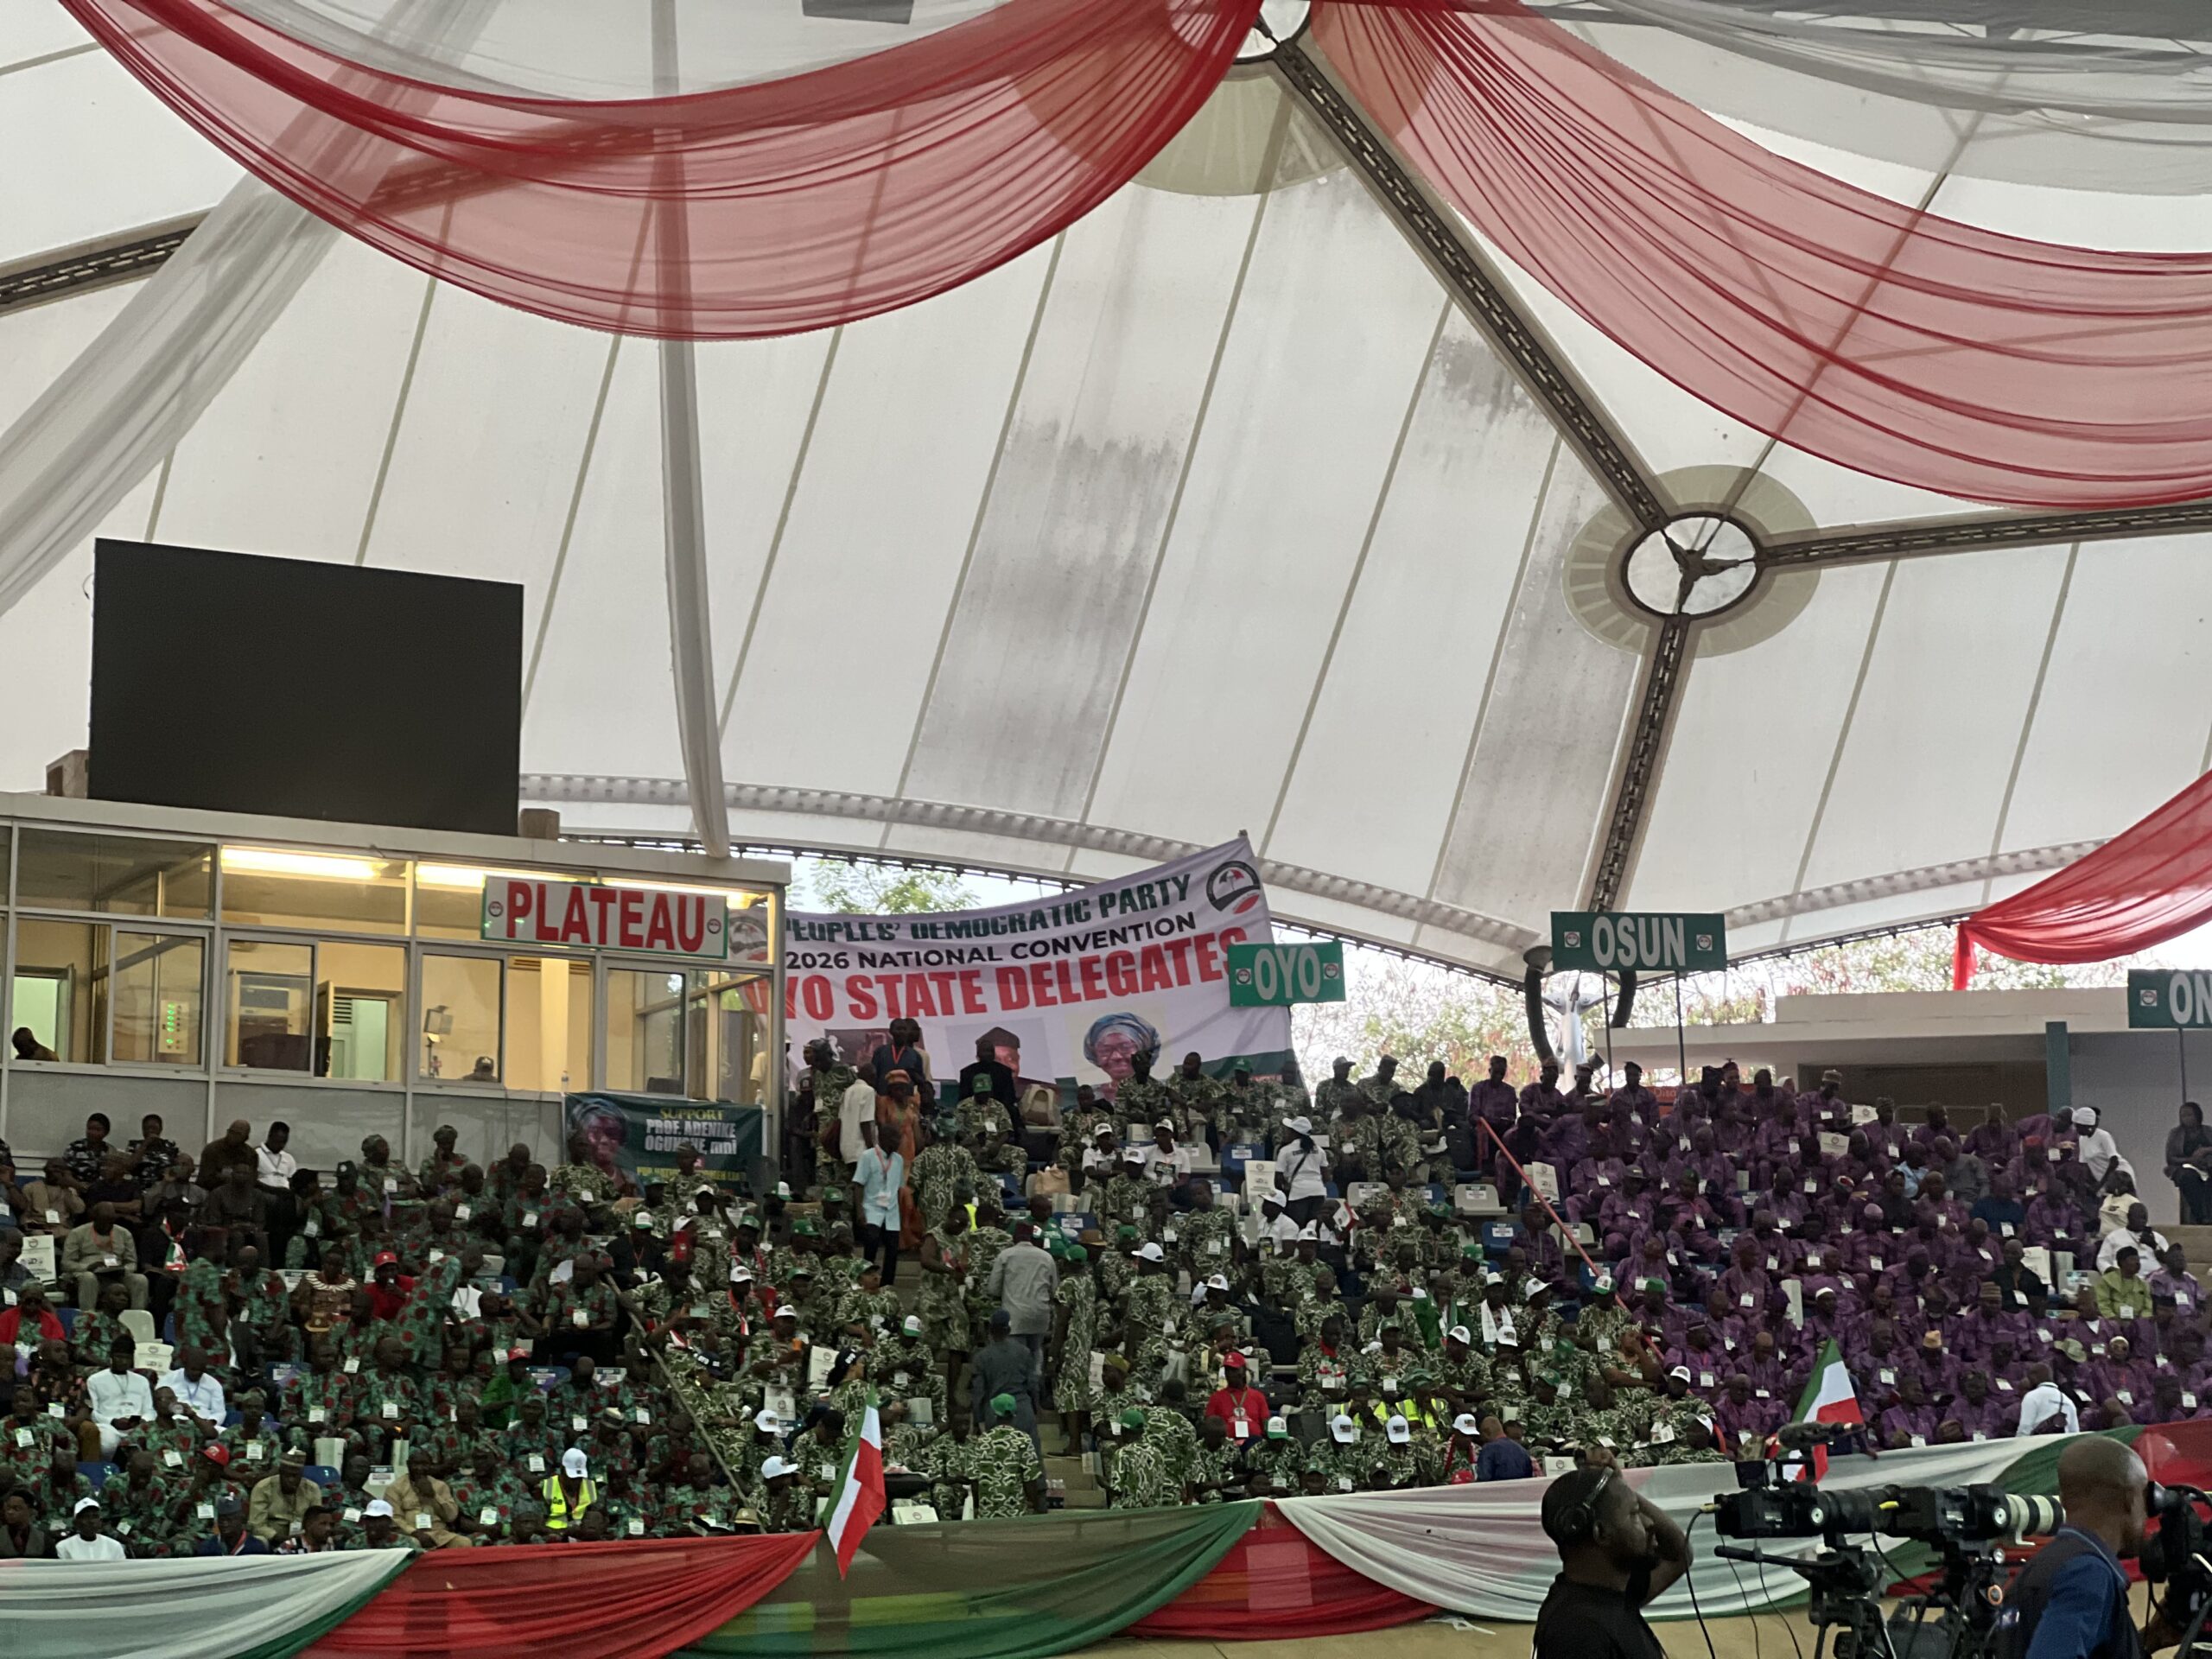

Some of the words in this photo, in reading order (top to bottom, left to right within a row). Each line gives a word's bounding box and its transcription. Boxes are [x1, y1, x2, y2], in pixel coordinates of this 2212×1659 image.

[505, 880, 705, 952] PLATEAU
[911, 899, 1090, 940] DEMOCRATIC
[1099, 873, 1191, 918] PARTY
[785, 950, 849, 969] 2026
[859, 945, 1002, 969] NATIONAL
[1011, 912, 1196, 960] CONVENTION
[1592, 916, 1687, 967] OSUN
[845, 969, 988, 1020] STATE
[1254, 946, 1321, 1001] OYO
[645, 1118, 682, 1135] PROF.
[683, 1120, 736, 1139] ADENIKE
[659, 1108, 725, 1121] SUPPORT
